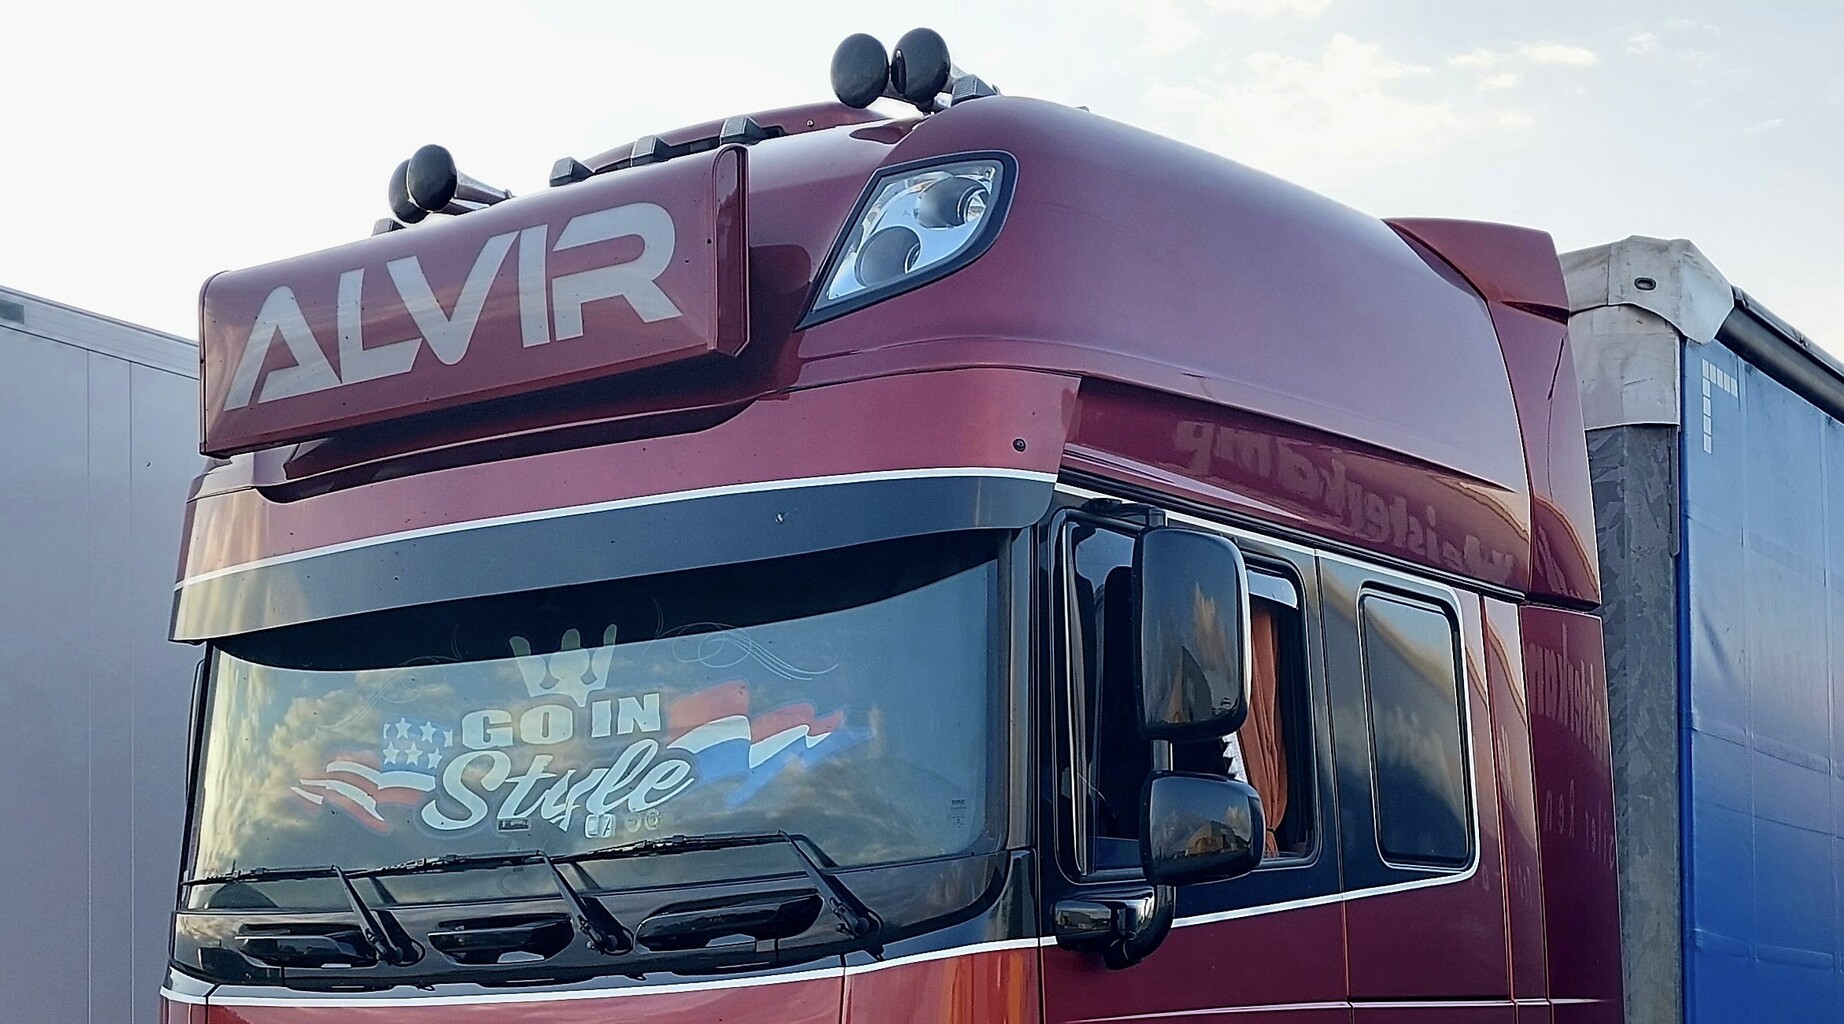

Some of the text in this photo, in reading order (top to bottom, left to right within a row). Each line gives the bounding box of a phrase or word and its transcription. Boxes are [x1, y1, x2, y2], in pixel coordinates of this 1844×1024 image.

[223, 202, 683, 411] ALVIR
[461, 693, 661, 750] GO IN
[421, 739, 695, 832] Style
